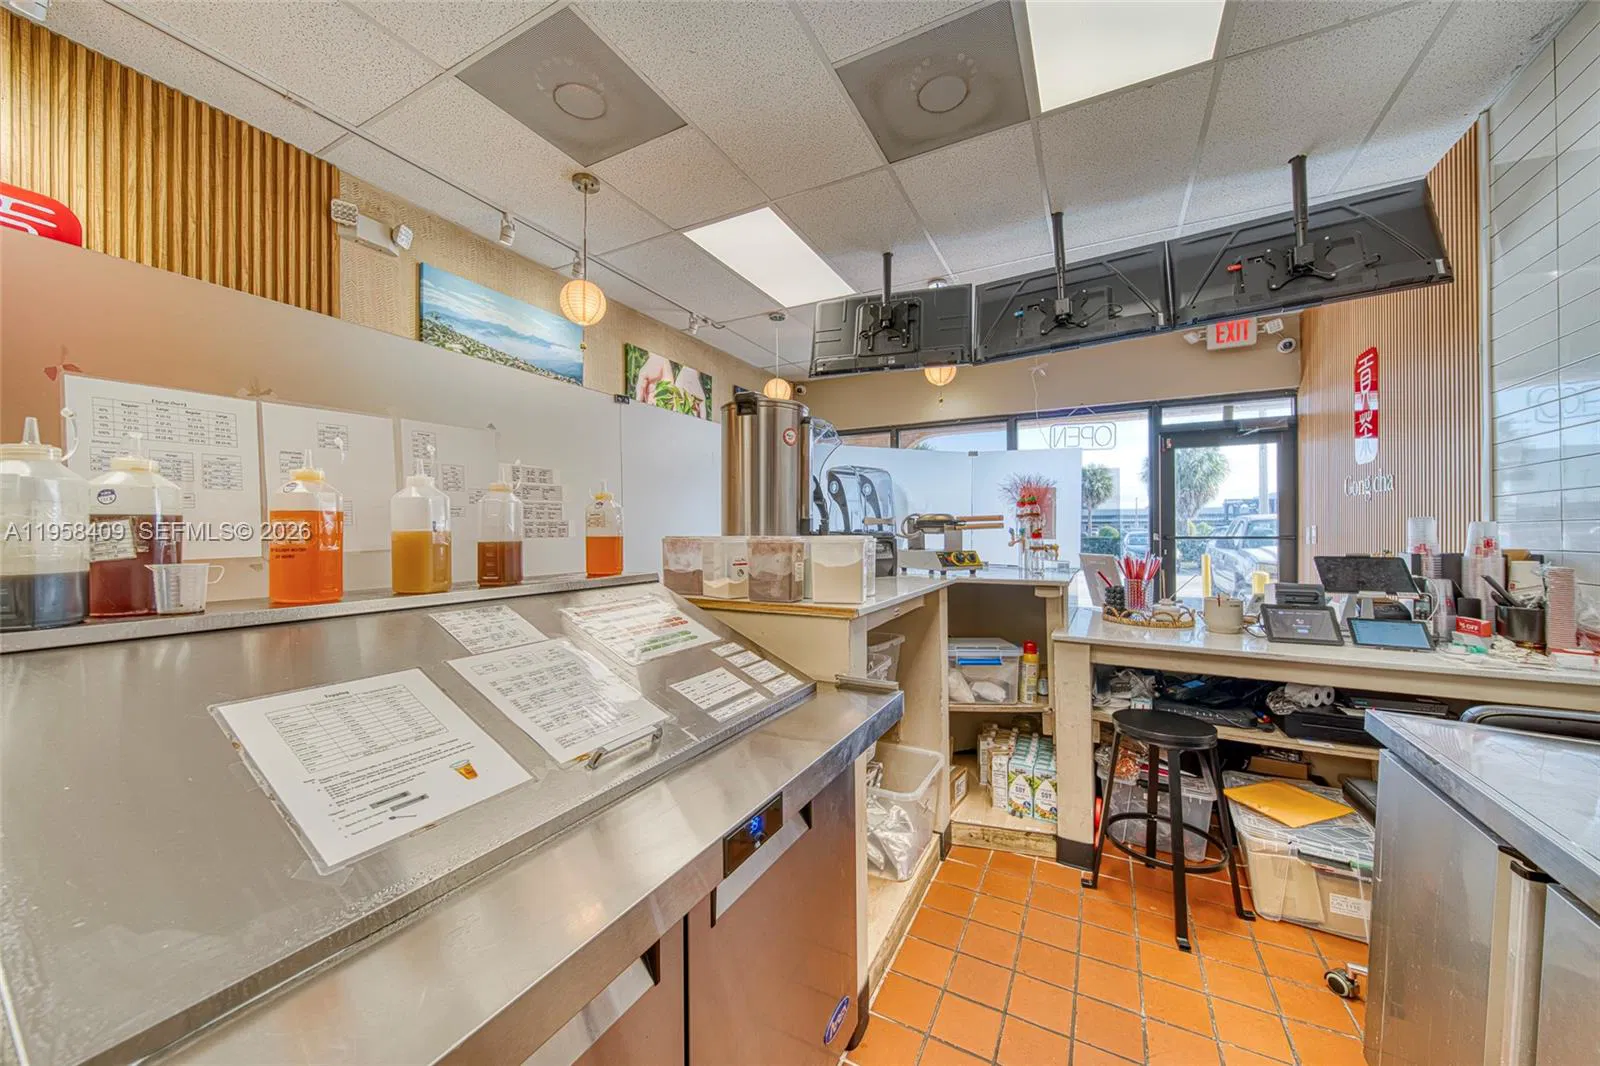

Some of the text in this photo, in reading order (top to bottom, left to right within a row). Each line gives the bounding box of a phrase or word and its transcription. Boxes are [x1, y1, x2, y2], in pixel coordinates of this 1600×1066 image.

[1216, 319, 1249, 344] EXIT
[1344, 467, 1395, 501] Gong cha
